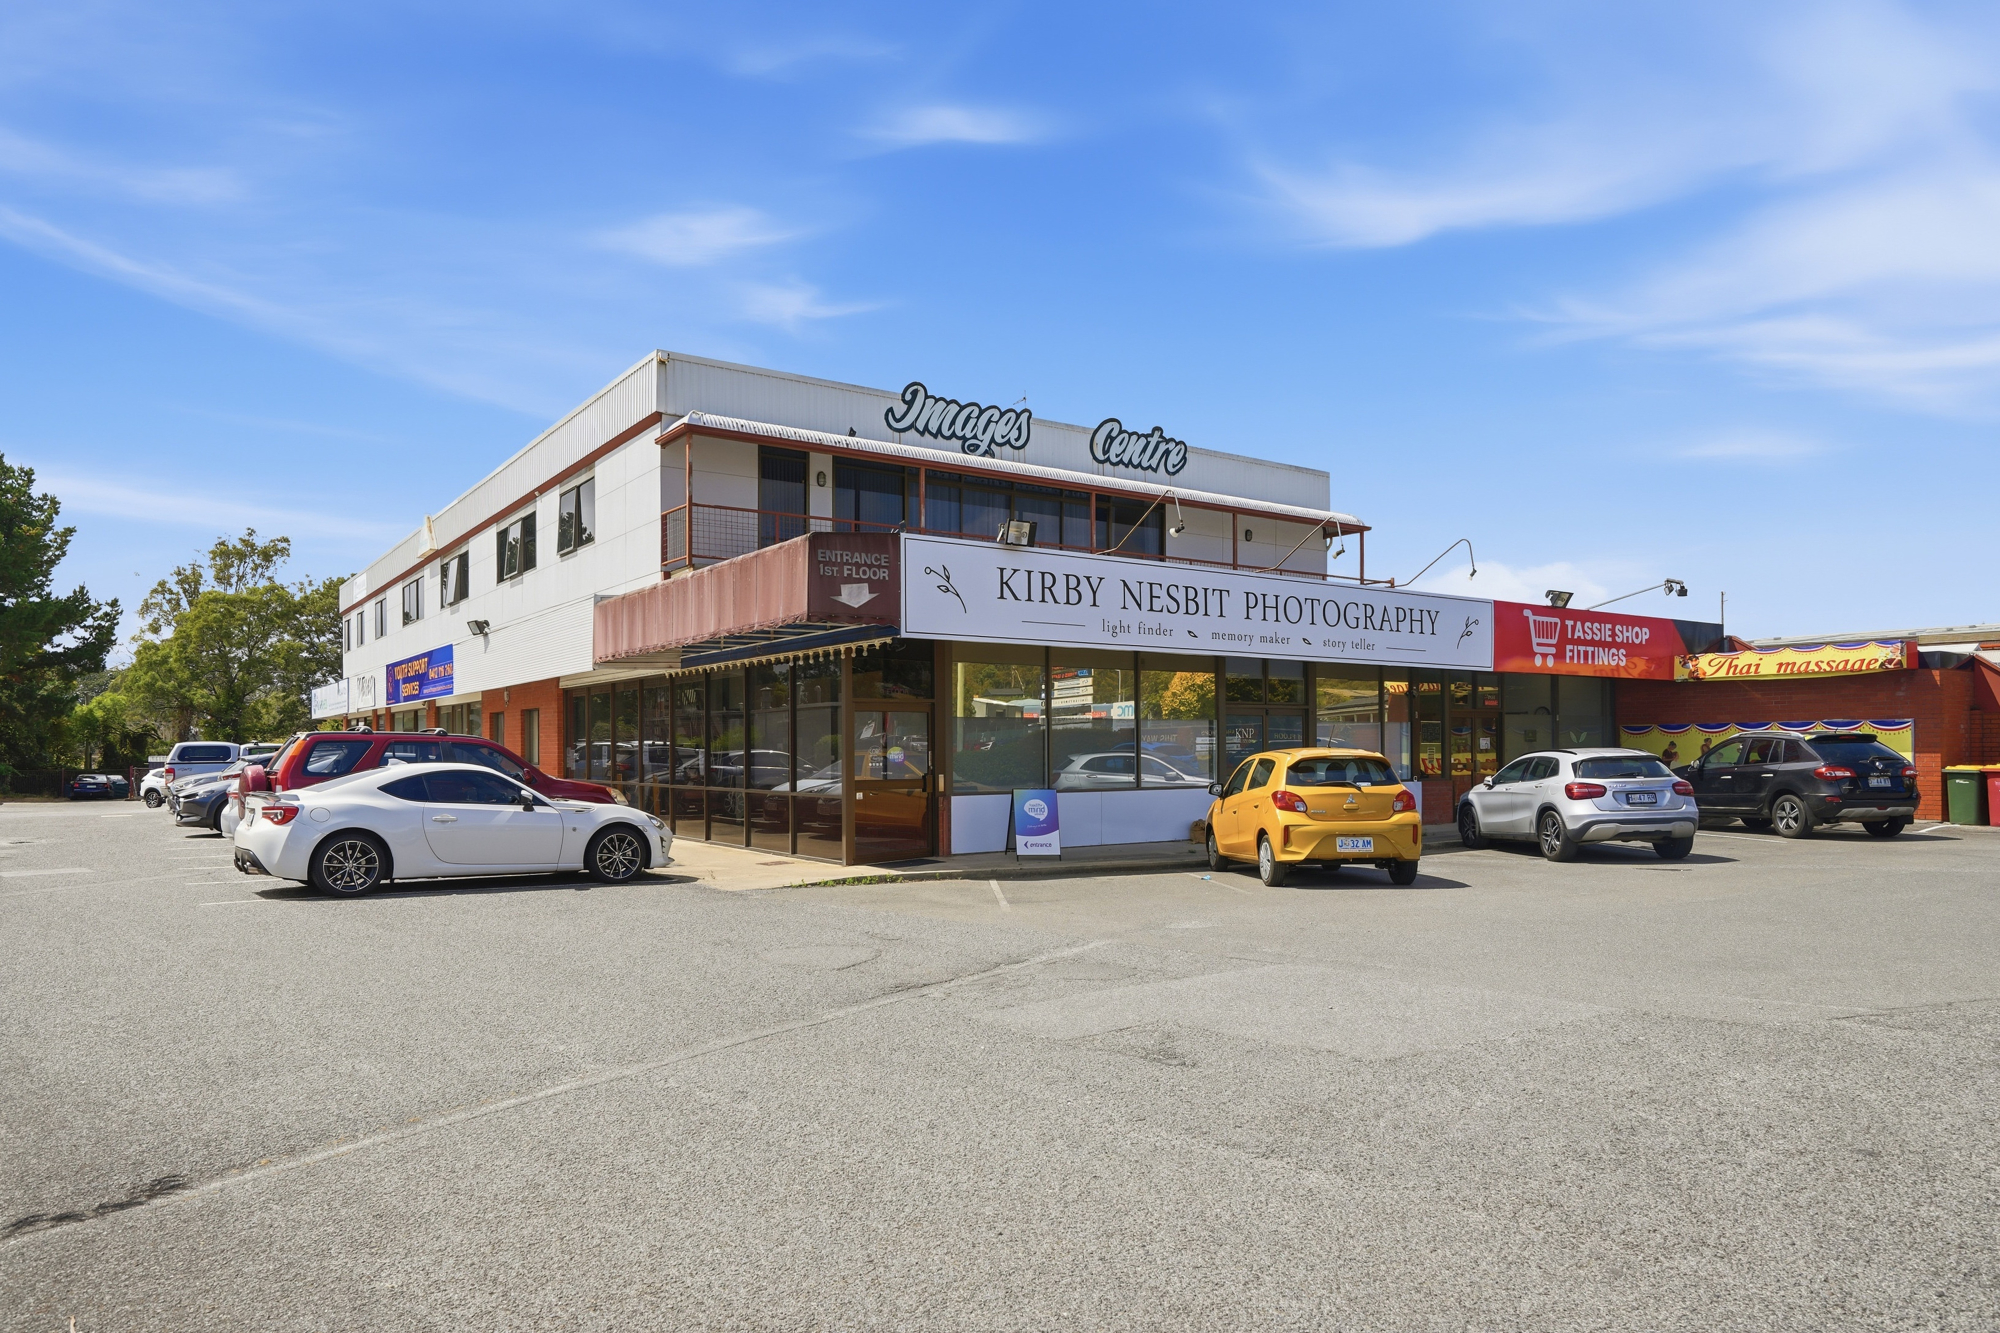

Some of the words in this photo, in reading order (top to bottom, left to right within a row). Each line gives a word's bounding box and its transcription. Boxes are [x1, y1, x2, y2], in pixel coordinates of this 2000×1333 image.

[885, 382, 1032, 457] Images
[1089, 418, 1188, 476] Centre
[817, 549, 890, 567] ENTRANCE
[843, 565, 889, 581] FLOOR
[996, 566, 1105, 608] KIRBY
[1120, 579, 1231, 620] NESBIT
[1243, 591, 1440, 637] PHOTOGRAPHY
[1102, 619, 1131, 638] light
[1138, 621, 1174, 637] finder
[1211, 630, 1255, 647] memory
[1259, 631, 1291, 645] maker
[1322, 638, 1347, 652] story
[1351, 638, 1376, 651] teller
[1565, 620, 1612, 642] TASSIE
[1615, 624, 1650, 644] SHOP
[1565, 644, 1627, 667] FITTINGS
[408, 657, 429, 677] SUPPORT
[1706, 656, 1762, 677] Thai
[1776, 657, 1880, 674] massage
[402, 681, 419, 697] SERVICES
[1235, 728, 1255, 739] KNP
[1338, 839, 1344, 848] J
[1350, 839, 1360, 848] 32
[1361, 839, 1372, 848] AM
